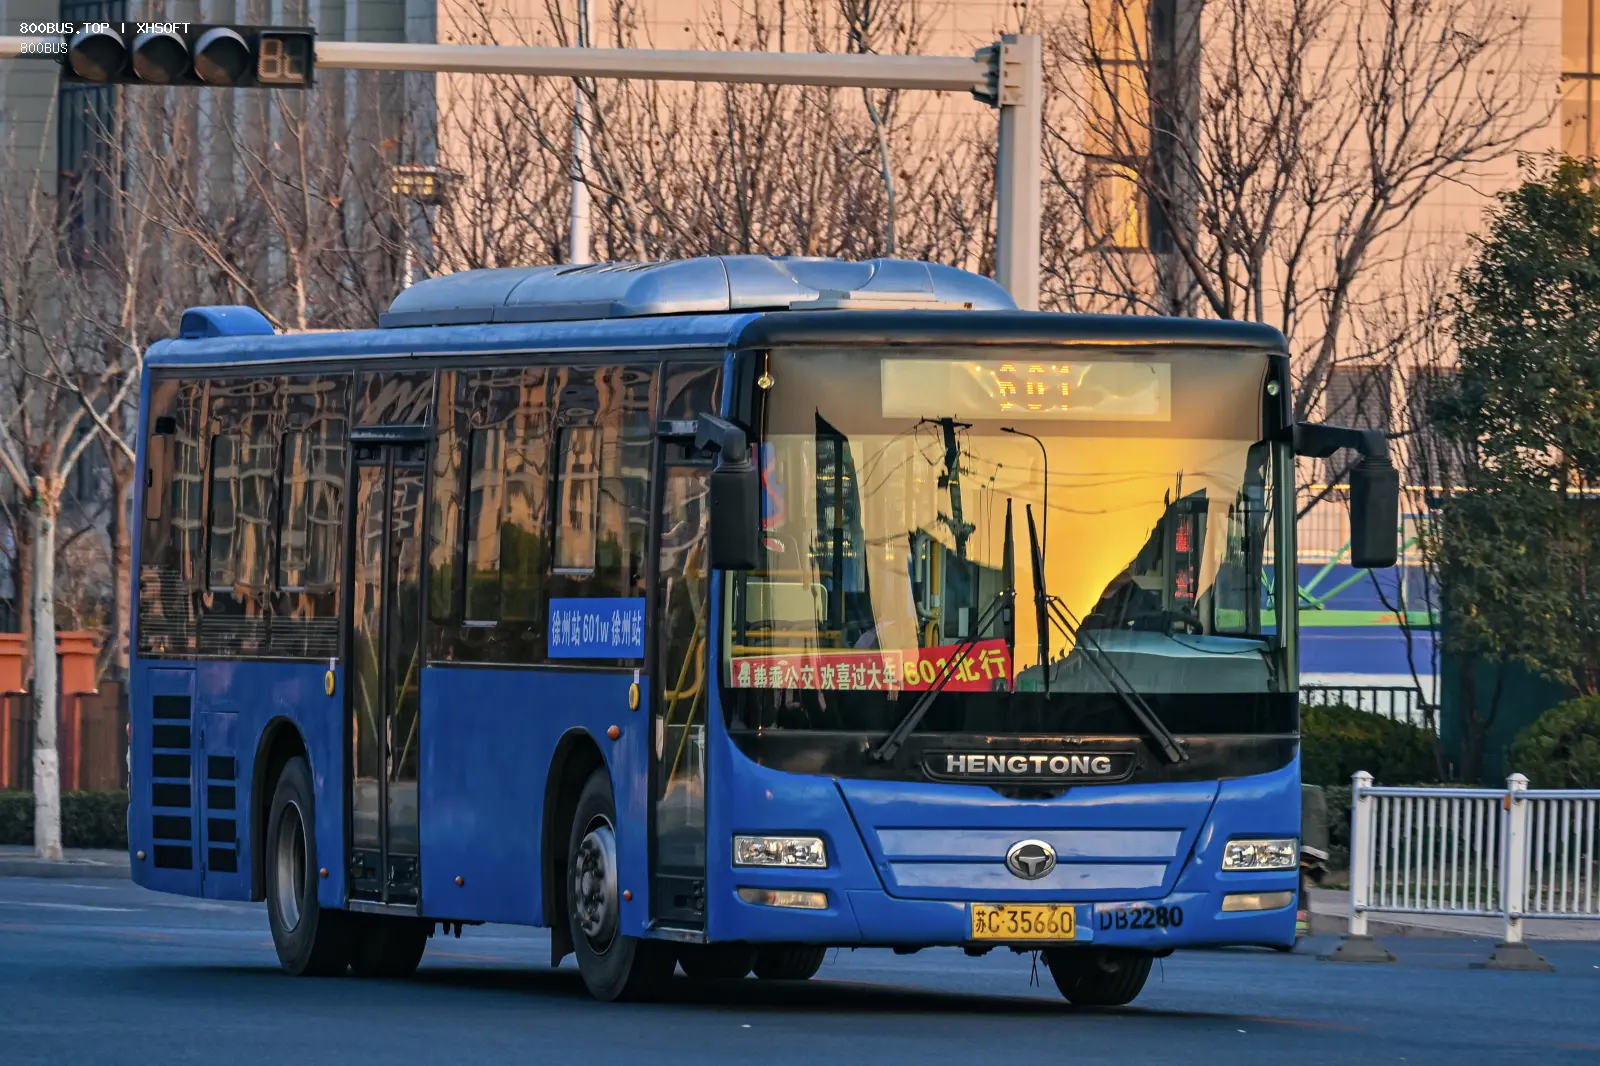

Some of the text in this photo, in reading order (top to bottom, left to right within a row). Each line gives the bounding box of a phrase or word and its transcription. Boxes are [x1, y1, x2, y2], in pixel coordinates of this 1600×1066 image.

[552, 609, 581, 647] 徐州站
[611, 609, 642, 647] 徐州站
[820, 660, 898, 690] 欢喜过大年
[946, 754, 1112, 774] HENGTONG
[1099, 906, 1184, 930] DB2280
